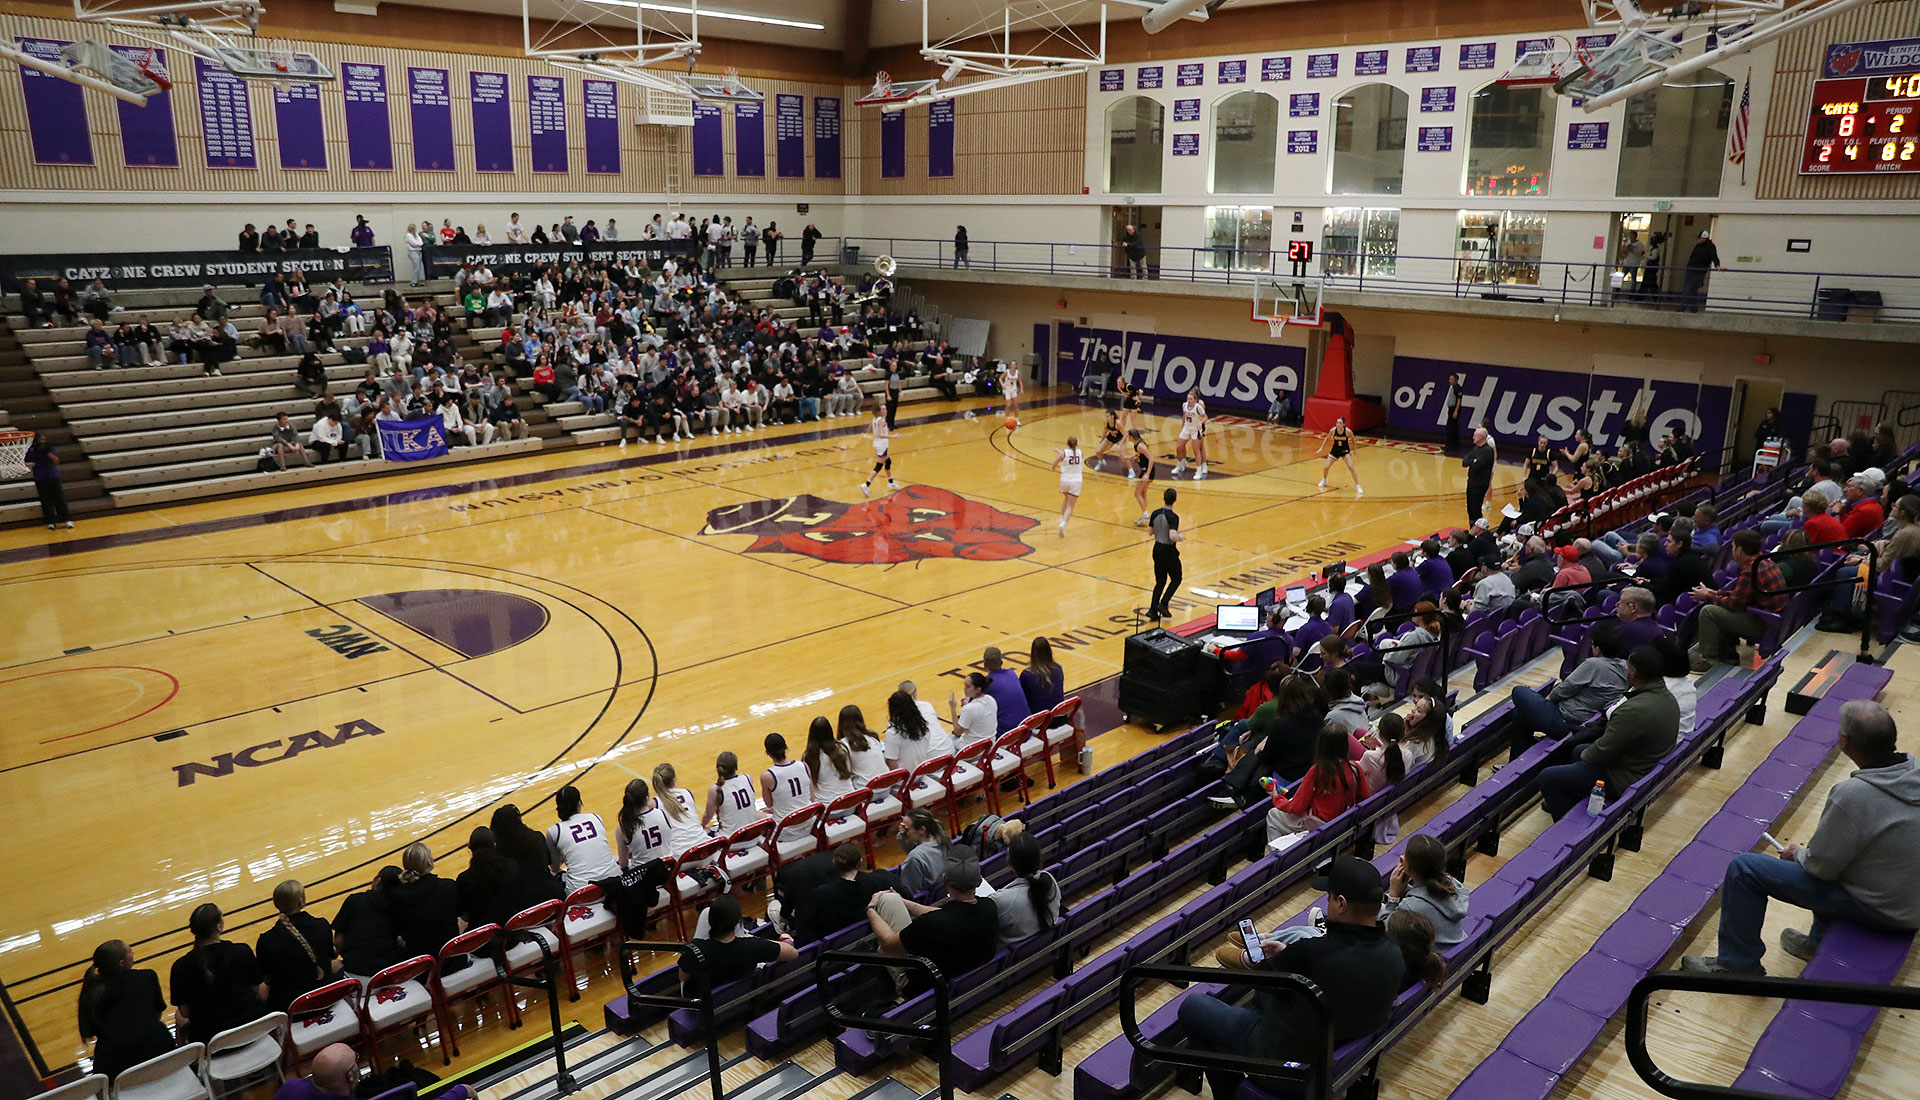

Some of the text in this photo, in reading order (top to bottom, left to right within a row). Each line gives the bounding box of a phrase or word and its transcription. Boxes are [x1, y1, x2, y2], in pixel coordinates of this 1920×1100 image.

[1839, 115, 1855, 136] 8
[1890, 114, 1904, 133] 2
[1819, 144, 1832, 162] 2
[1844, 144, 1858, 160] 4
[563, 251, 614, 262] STUENT
[1289, 242, 1308, 259] 27
[151, 264, 200, 277] CREW
[206, 262, 277, 276] STUDENT
[1079, 337, 1298, 404] The House
[1394, 382, 1436, 410] of
[1069, 456, 1080, 464] 20
[304, 624, 391, 660] NWC
[172, 718, 386, 788] NCAA
[788, 777, 802, 797] 11
[732, 788, 751, 810] 10
[569, 821, 598, 843] 23
[642, 826, 662, 849] 15
